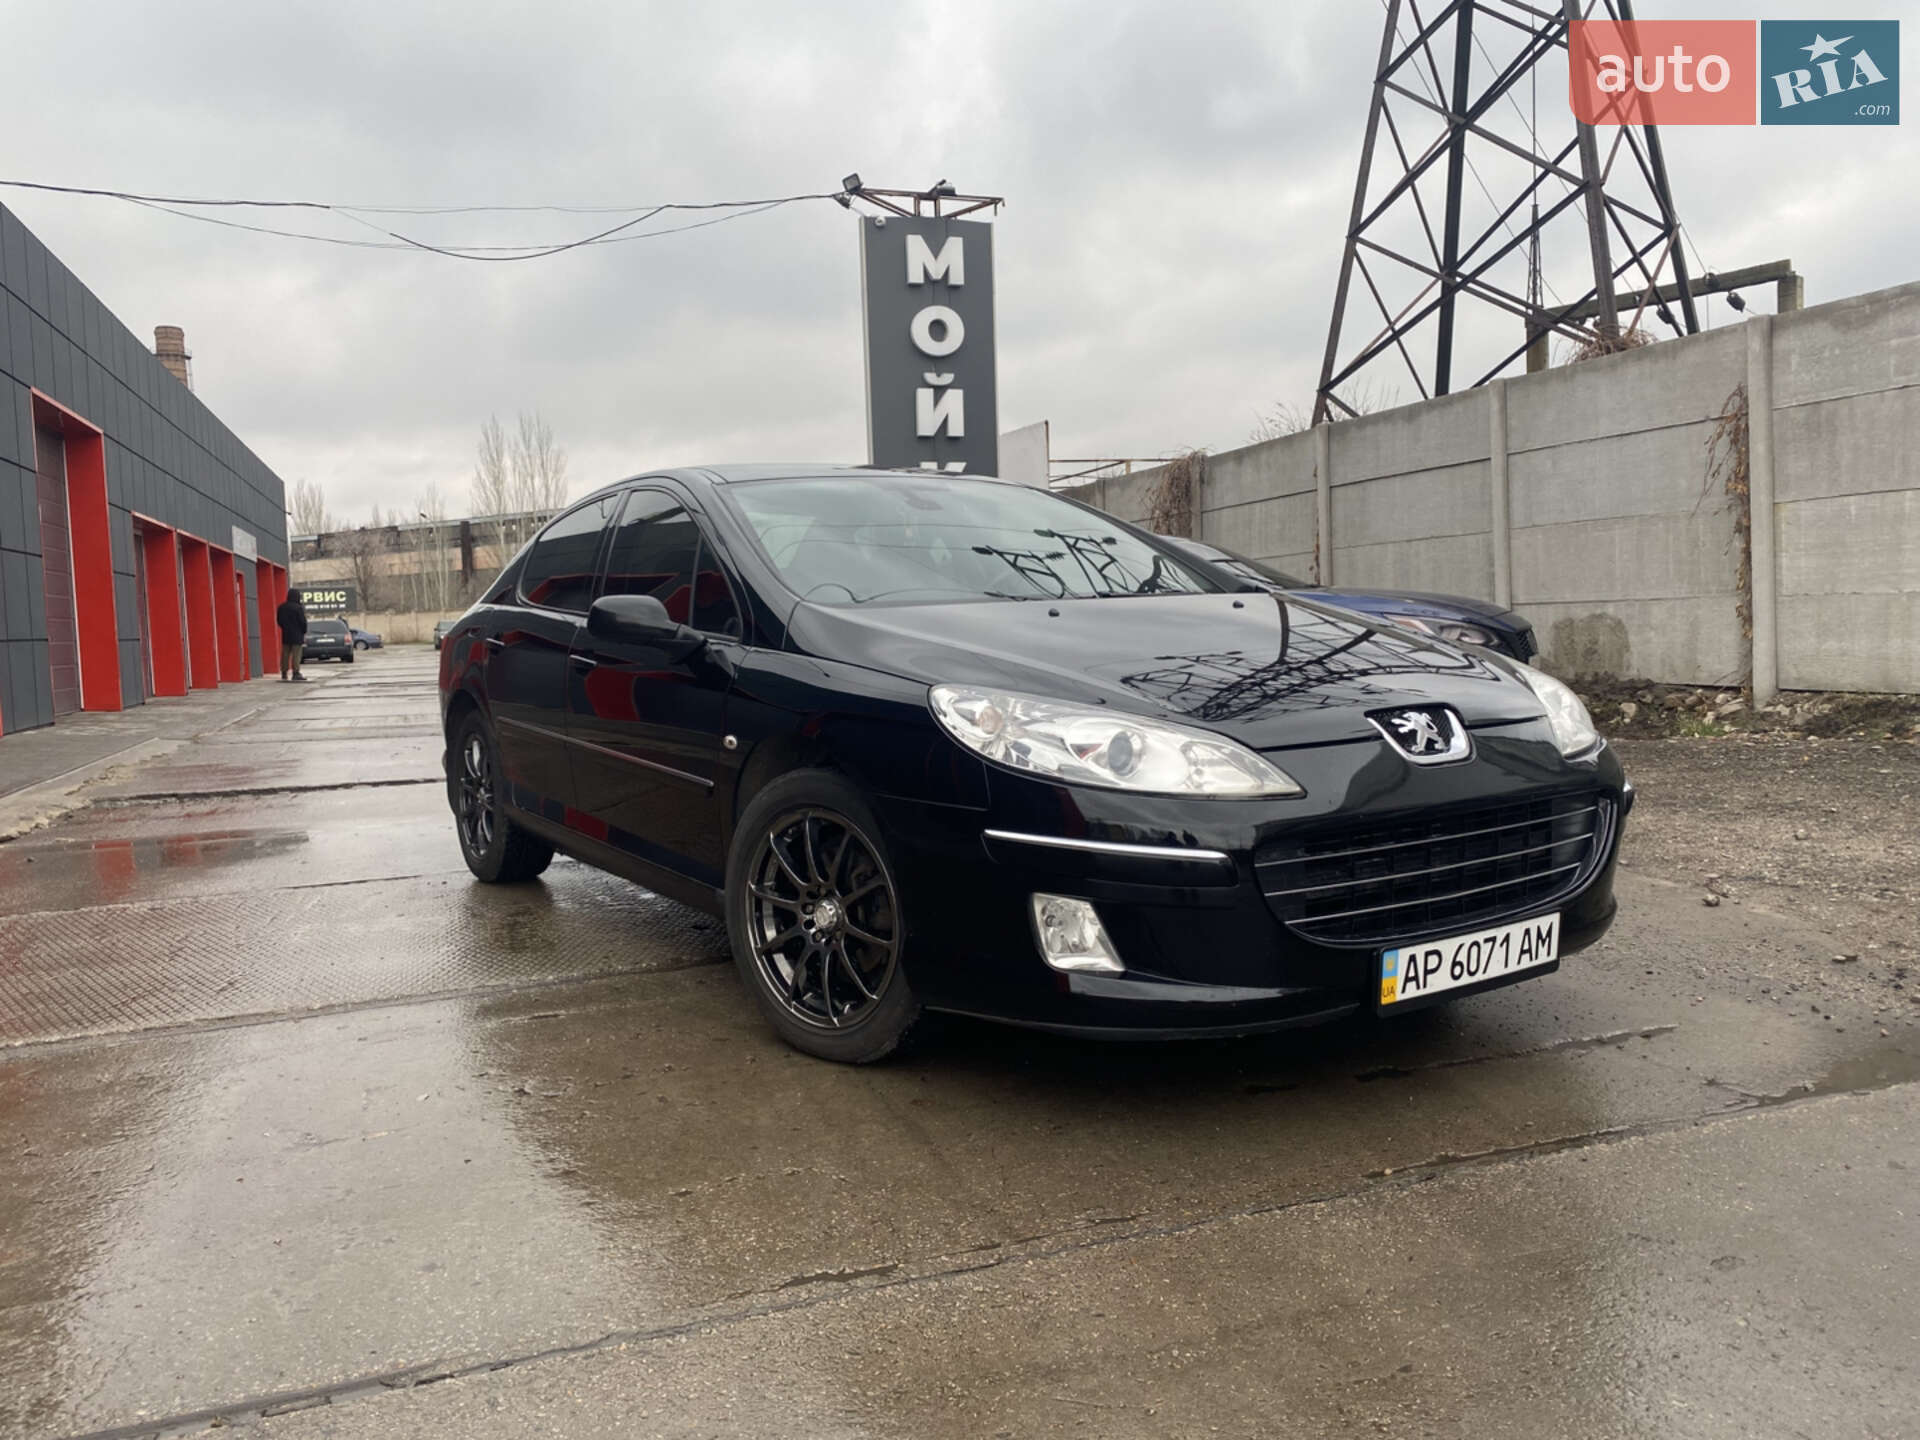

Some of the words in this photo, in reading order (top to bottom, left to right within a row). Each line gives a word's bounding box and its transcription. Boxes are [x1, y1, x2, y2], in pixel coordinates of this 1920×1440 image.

[905, 234, 967, 472] МОЙ
[300, 591, 346, 603] РВИС
[1401, 949, 1442, 994] AP
[1451, 932, 1511, 980] 6071
[1517, 921, 1553, 965] AM
